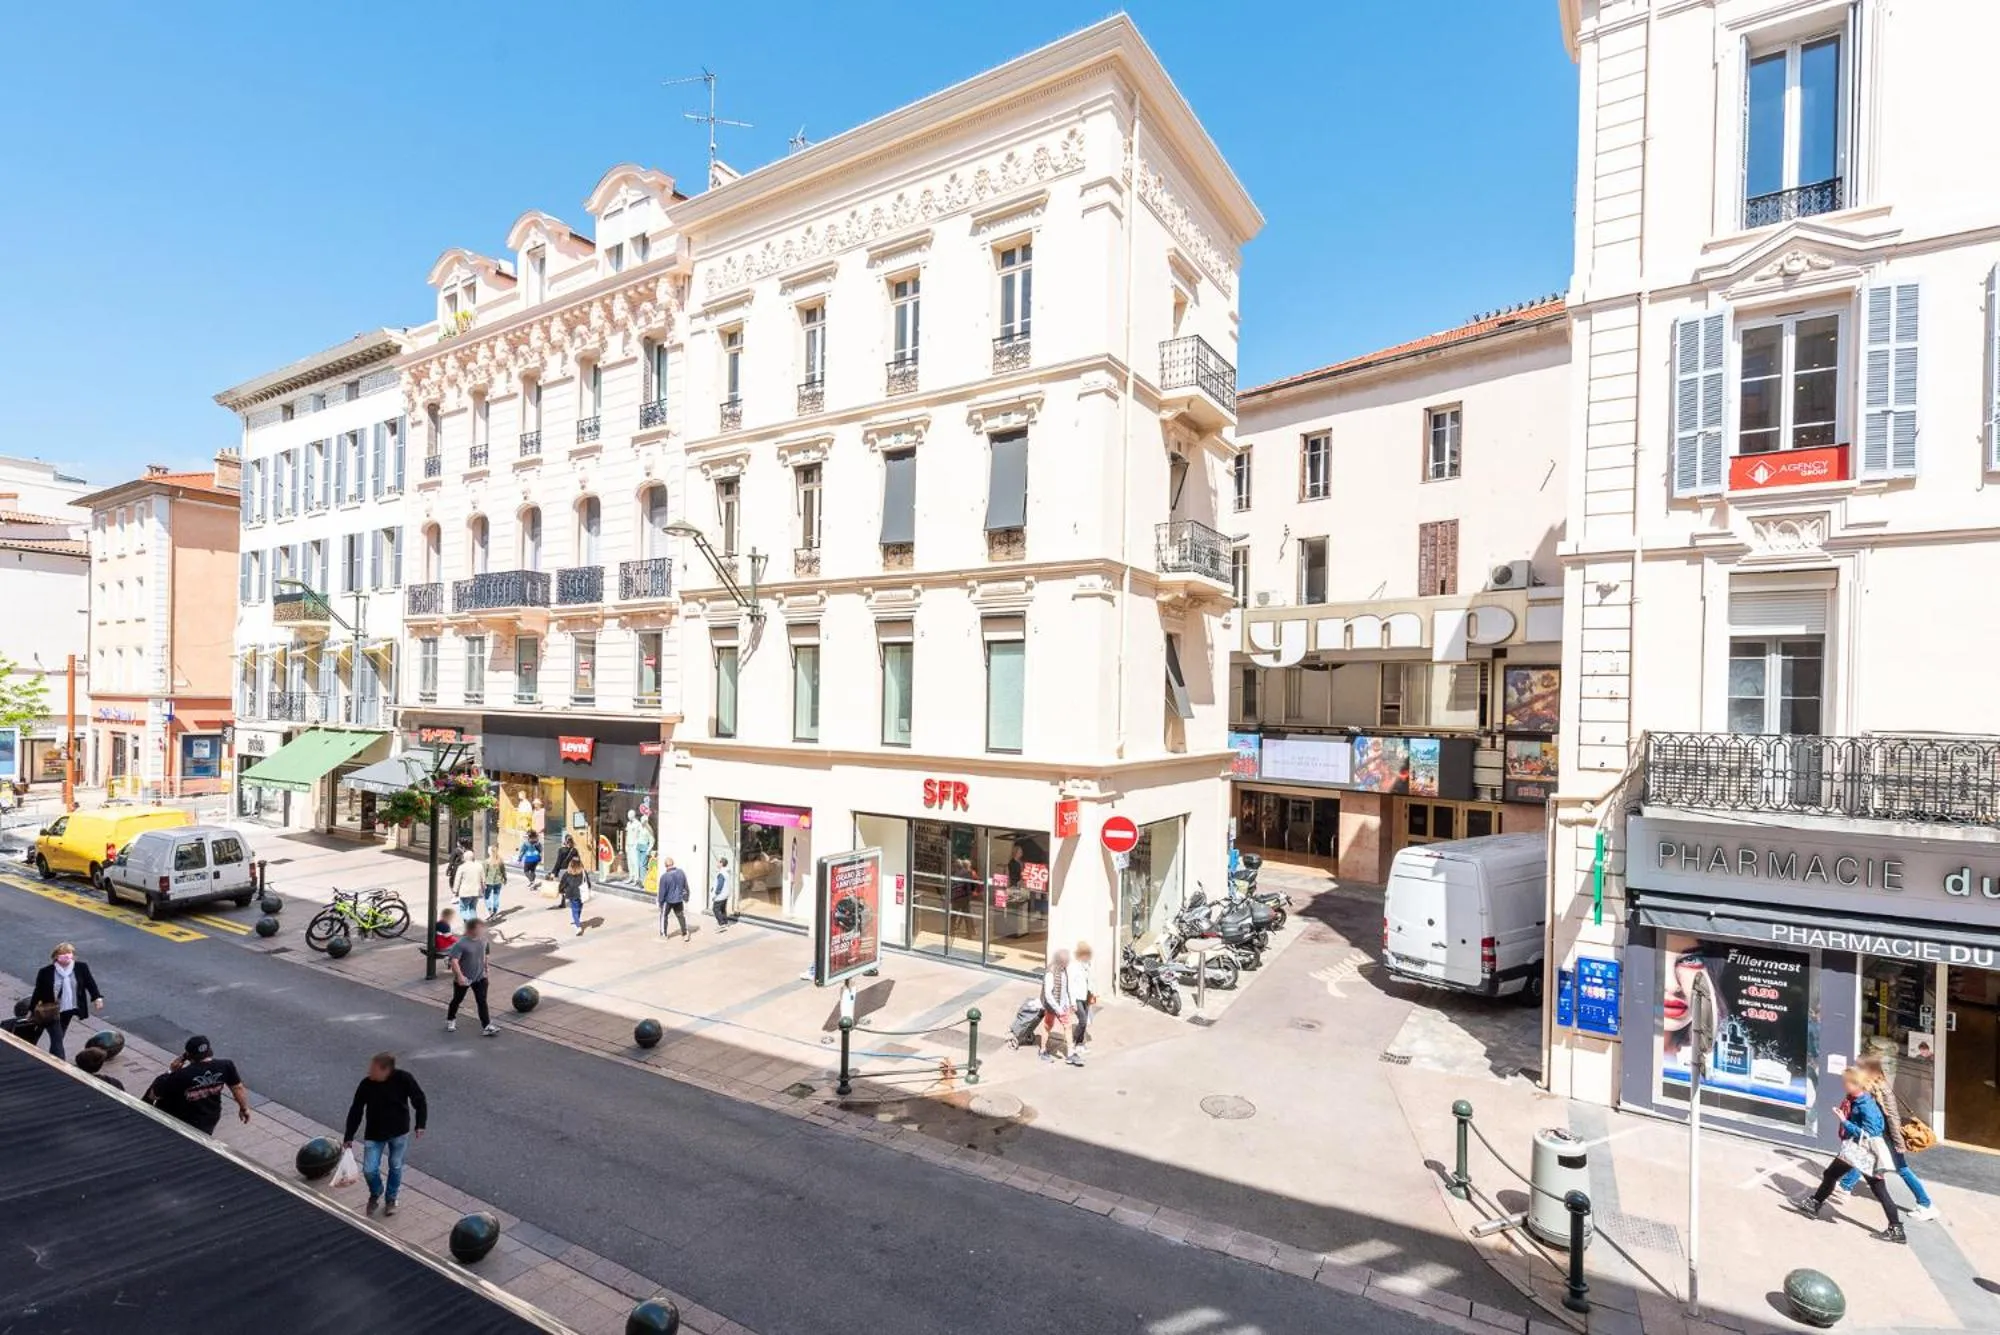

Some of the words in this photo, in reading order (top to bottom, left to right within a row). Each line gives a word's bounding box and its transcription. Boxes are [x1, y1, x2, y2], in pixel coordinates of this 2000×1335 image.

[1779, 460, 1829, 473] AGENCY
[1801, 469, 1829, 477] GROUP
[923, 778, 969, 812] SFR
[1063, 811, 1079, 826] SFR
[1031, 864, 1049, 883] 5G
[1658, 842, 1905, 890] PHARMACIE
[1944, 867, 2000, 899] du
[1772, 924, 1942, 961] PHARMACIE
[1949, 944, 1994, 966] DU
[1727, 953, 1801, 972] Fillermast
[1763, 978, 1788, 988] VISAGE
[1763, 1003, 1788, 1012] VISAGE
